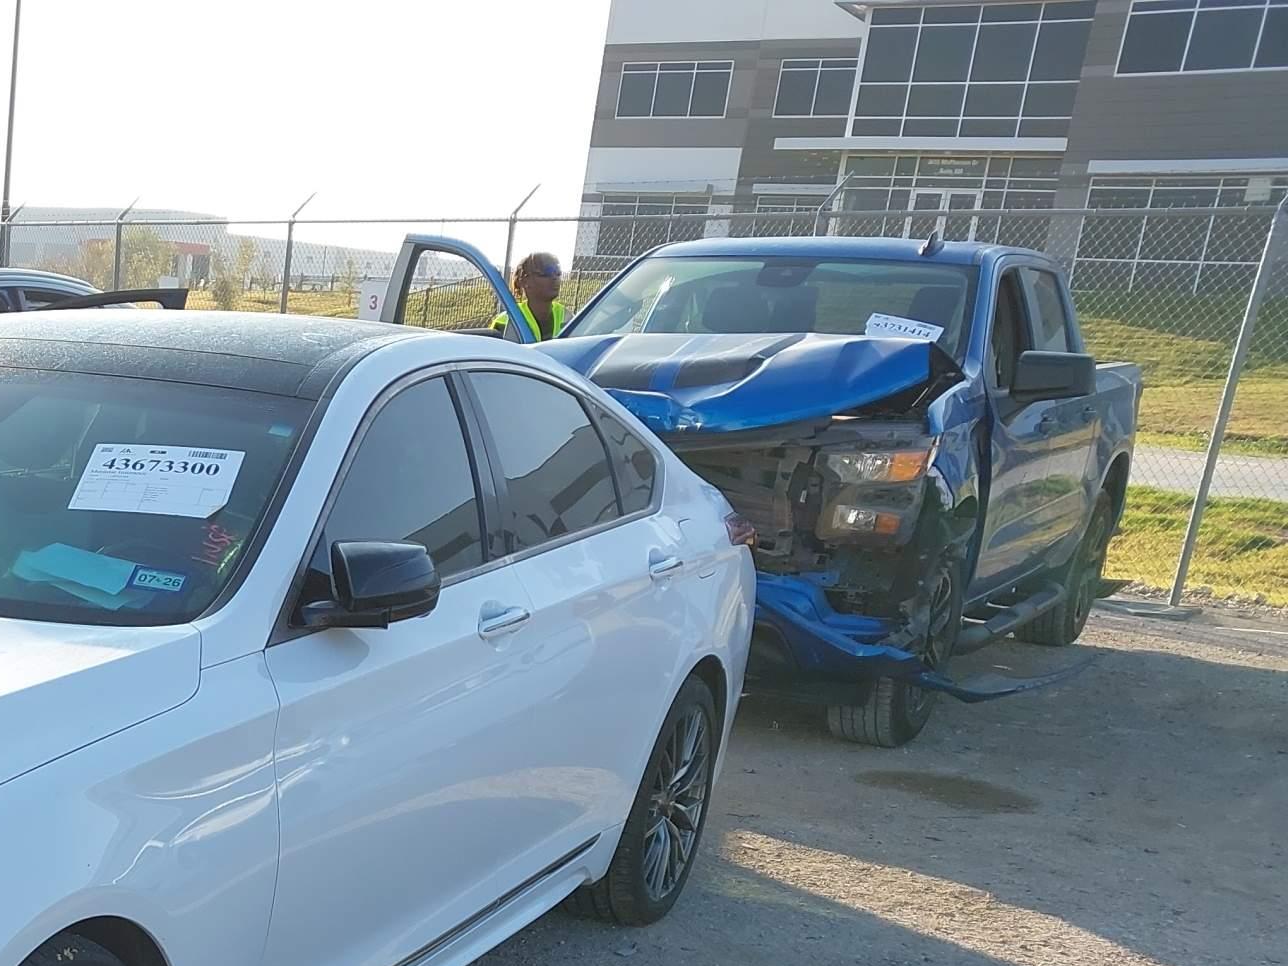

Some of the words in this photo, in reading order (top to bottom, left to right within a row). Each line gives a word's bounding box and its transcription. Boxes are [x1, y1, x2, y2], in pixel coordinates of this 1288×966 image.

[369, 295, 378, 310] 3
[103, 458, 220, 476] 43673300
[137, 574, 157, 584] 07
[163, 577, 182, 587] 26
